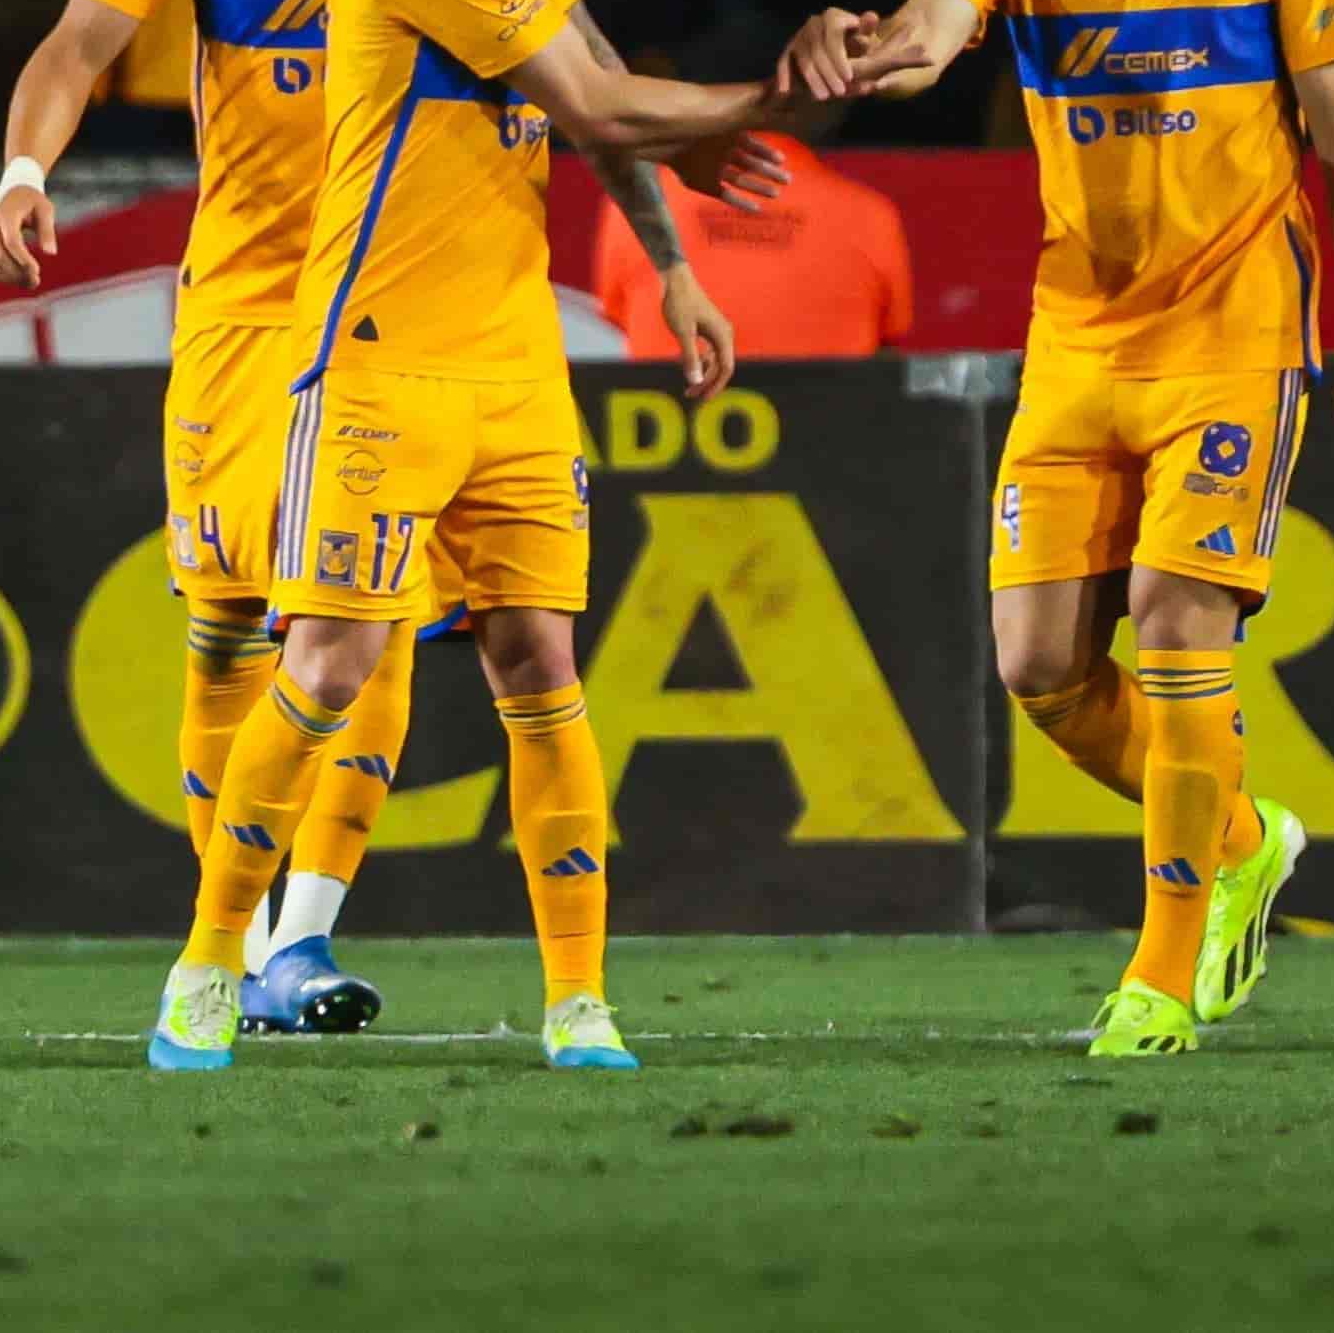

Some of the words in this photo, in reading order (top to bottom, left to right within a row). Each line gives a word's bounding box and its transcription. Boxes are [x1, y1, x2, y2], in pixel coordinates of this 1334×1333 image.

[1104, 46, 1209, 74] CEMEX
[1114, 108, 1197, 136] Bitso
[578, 387, 781, 473] DO
[199, 502, 233, 577] 4
[370, 511, 415, 593] 17
